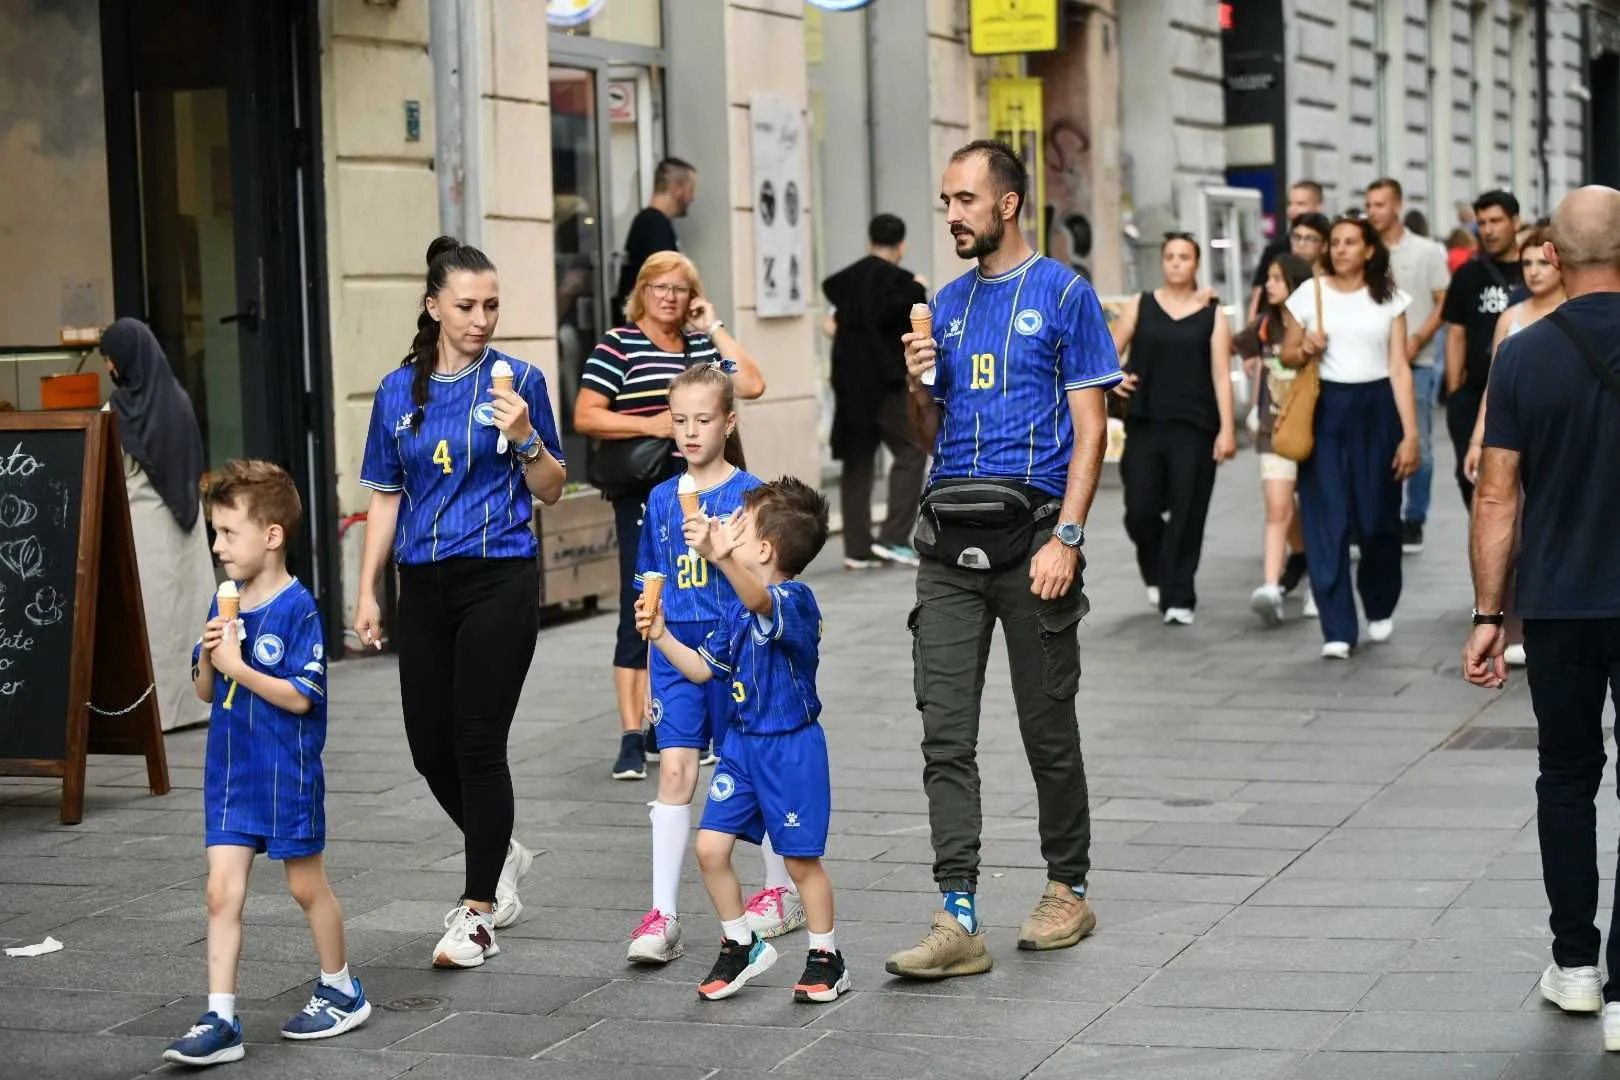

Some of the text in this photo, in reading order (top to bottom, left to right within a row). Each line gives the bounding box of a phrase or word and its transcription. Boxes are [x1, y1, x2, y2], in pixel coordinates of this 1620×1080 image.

[970, 353, 995, 389] 19
[433, 440, 453, 474] 4
[677, 554, 708, 589] 20
